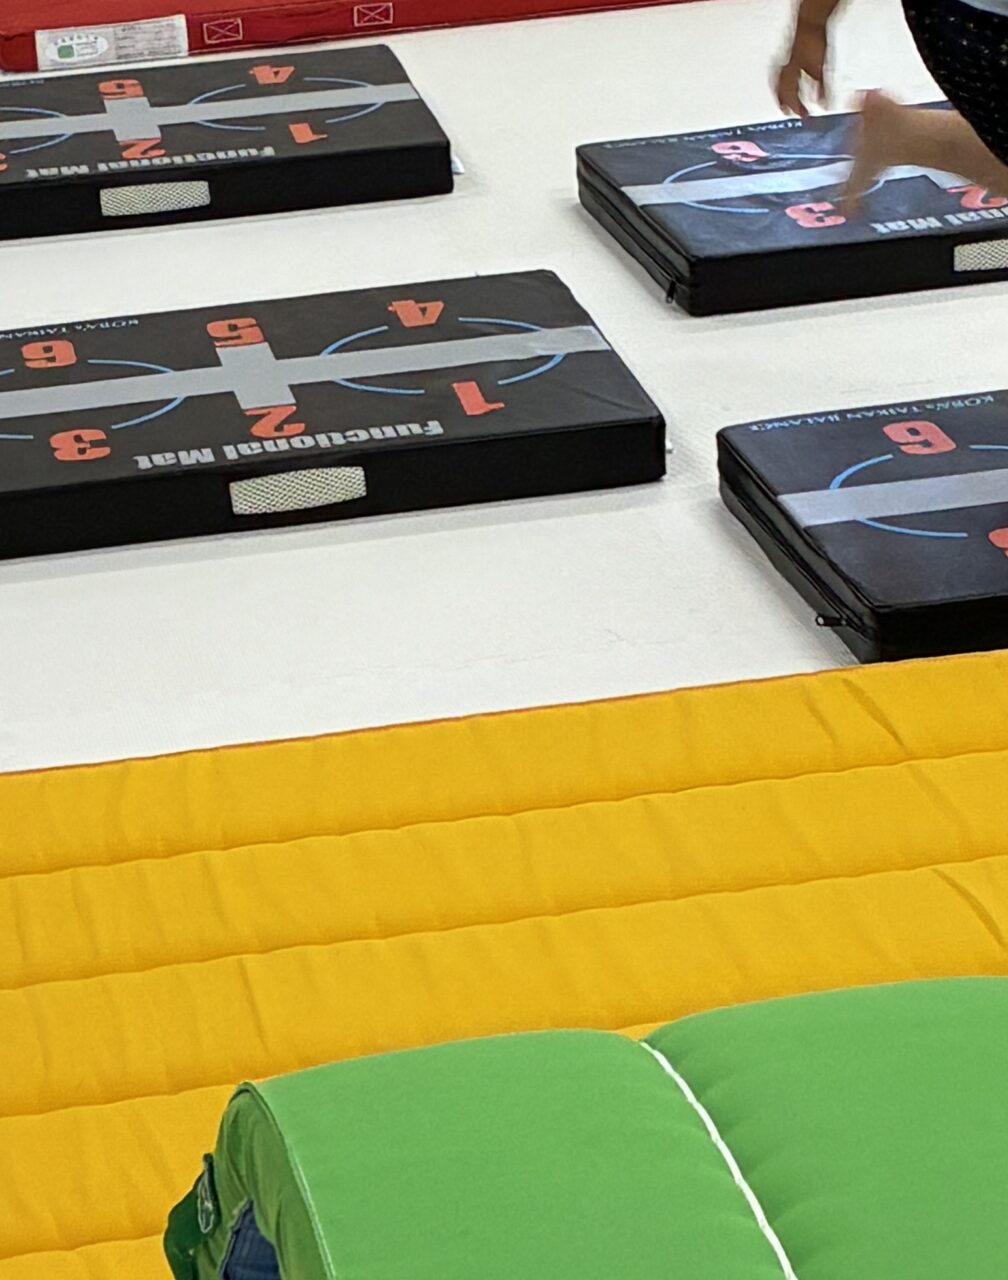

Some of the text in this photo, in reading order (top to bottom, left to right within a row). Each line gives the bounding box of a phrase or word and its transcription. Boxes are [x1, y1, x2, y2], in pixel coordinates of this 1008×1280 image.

[249, 65, 295, 85] 4
[26, 145, 276, 179] Functional Mat
[785, 202, 847, 228] 3
[869, 216, 945, 234] Mat
[388, 300, 445, 328] 4
[206, 317, 265, 347] 5
[20, 340, 77, 368] 6
[452, 380, 505, 416] 1
[244, 405, 306, 438] 2
[49, 429, 111, 461] 3
[132, 419, 445, 470] Functional Mat
[882, 420, 957, 455] 6
